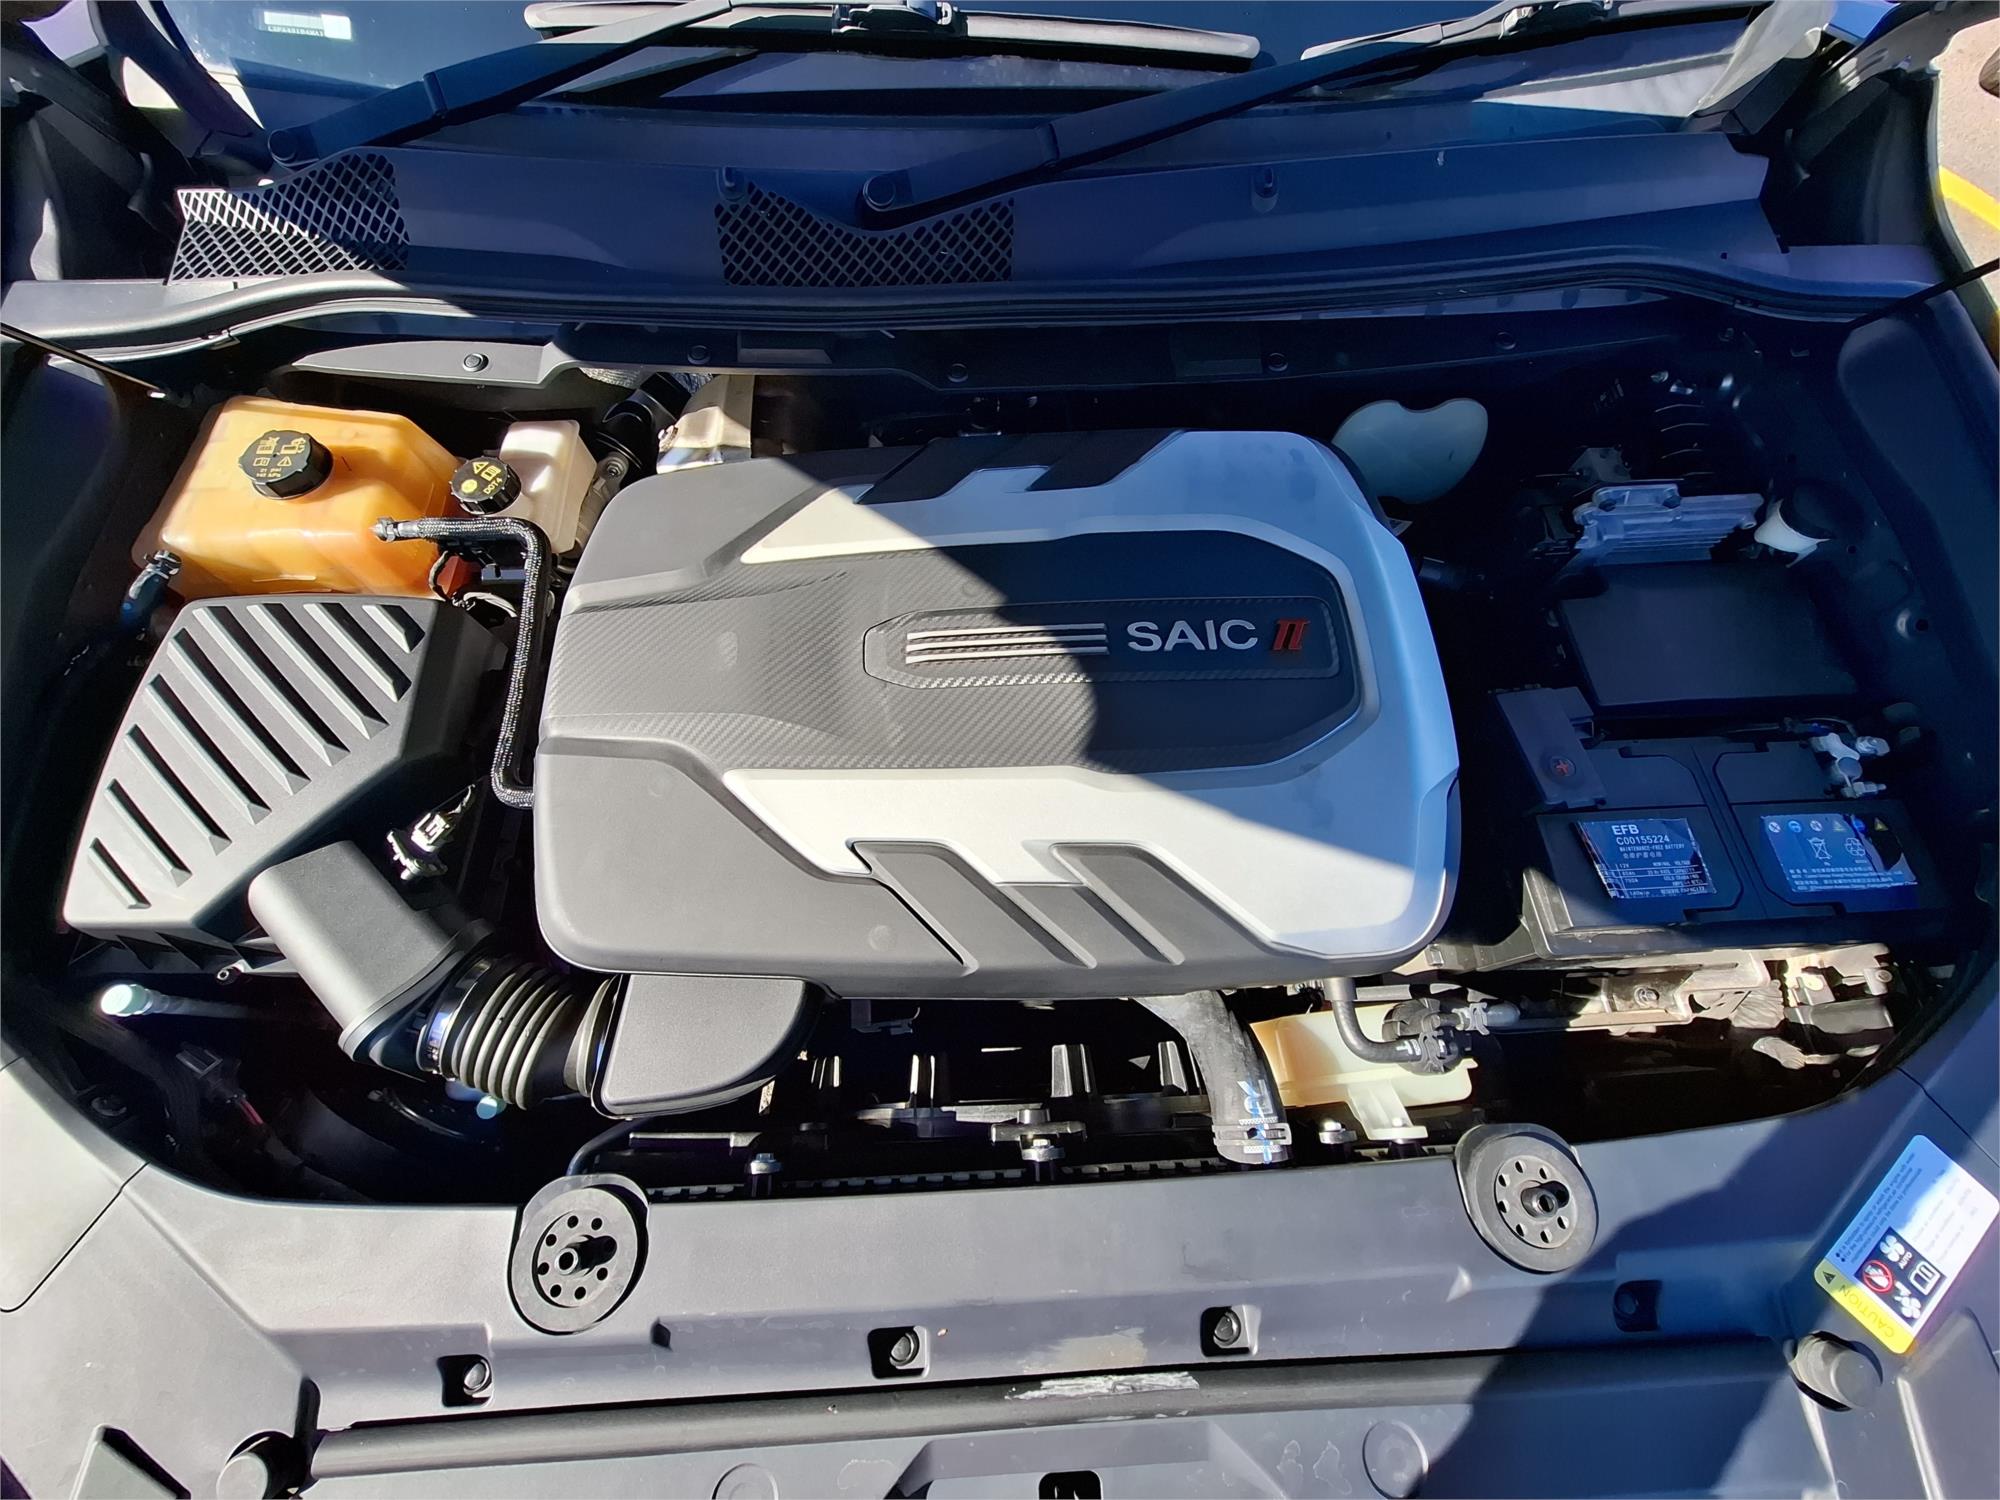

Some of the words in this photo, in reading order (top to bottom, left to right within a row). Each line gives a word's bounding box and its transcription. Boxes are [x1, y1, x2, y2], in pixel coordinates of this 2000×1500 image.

[1126, 619, 1258, 651] SAIC
[1611, 824, 1639, 835] EFB
[1616, 835, 1670, 845] C00155224
[1839, 1284, 1894, 1338] CAUTION
